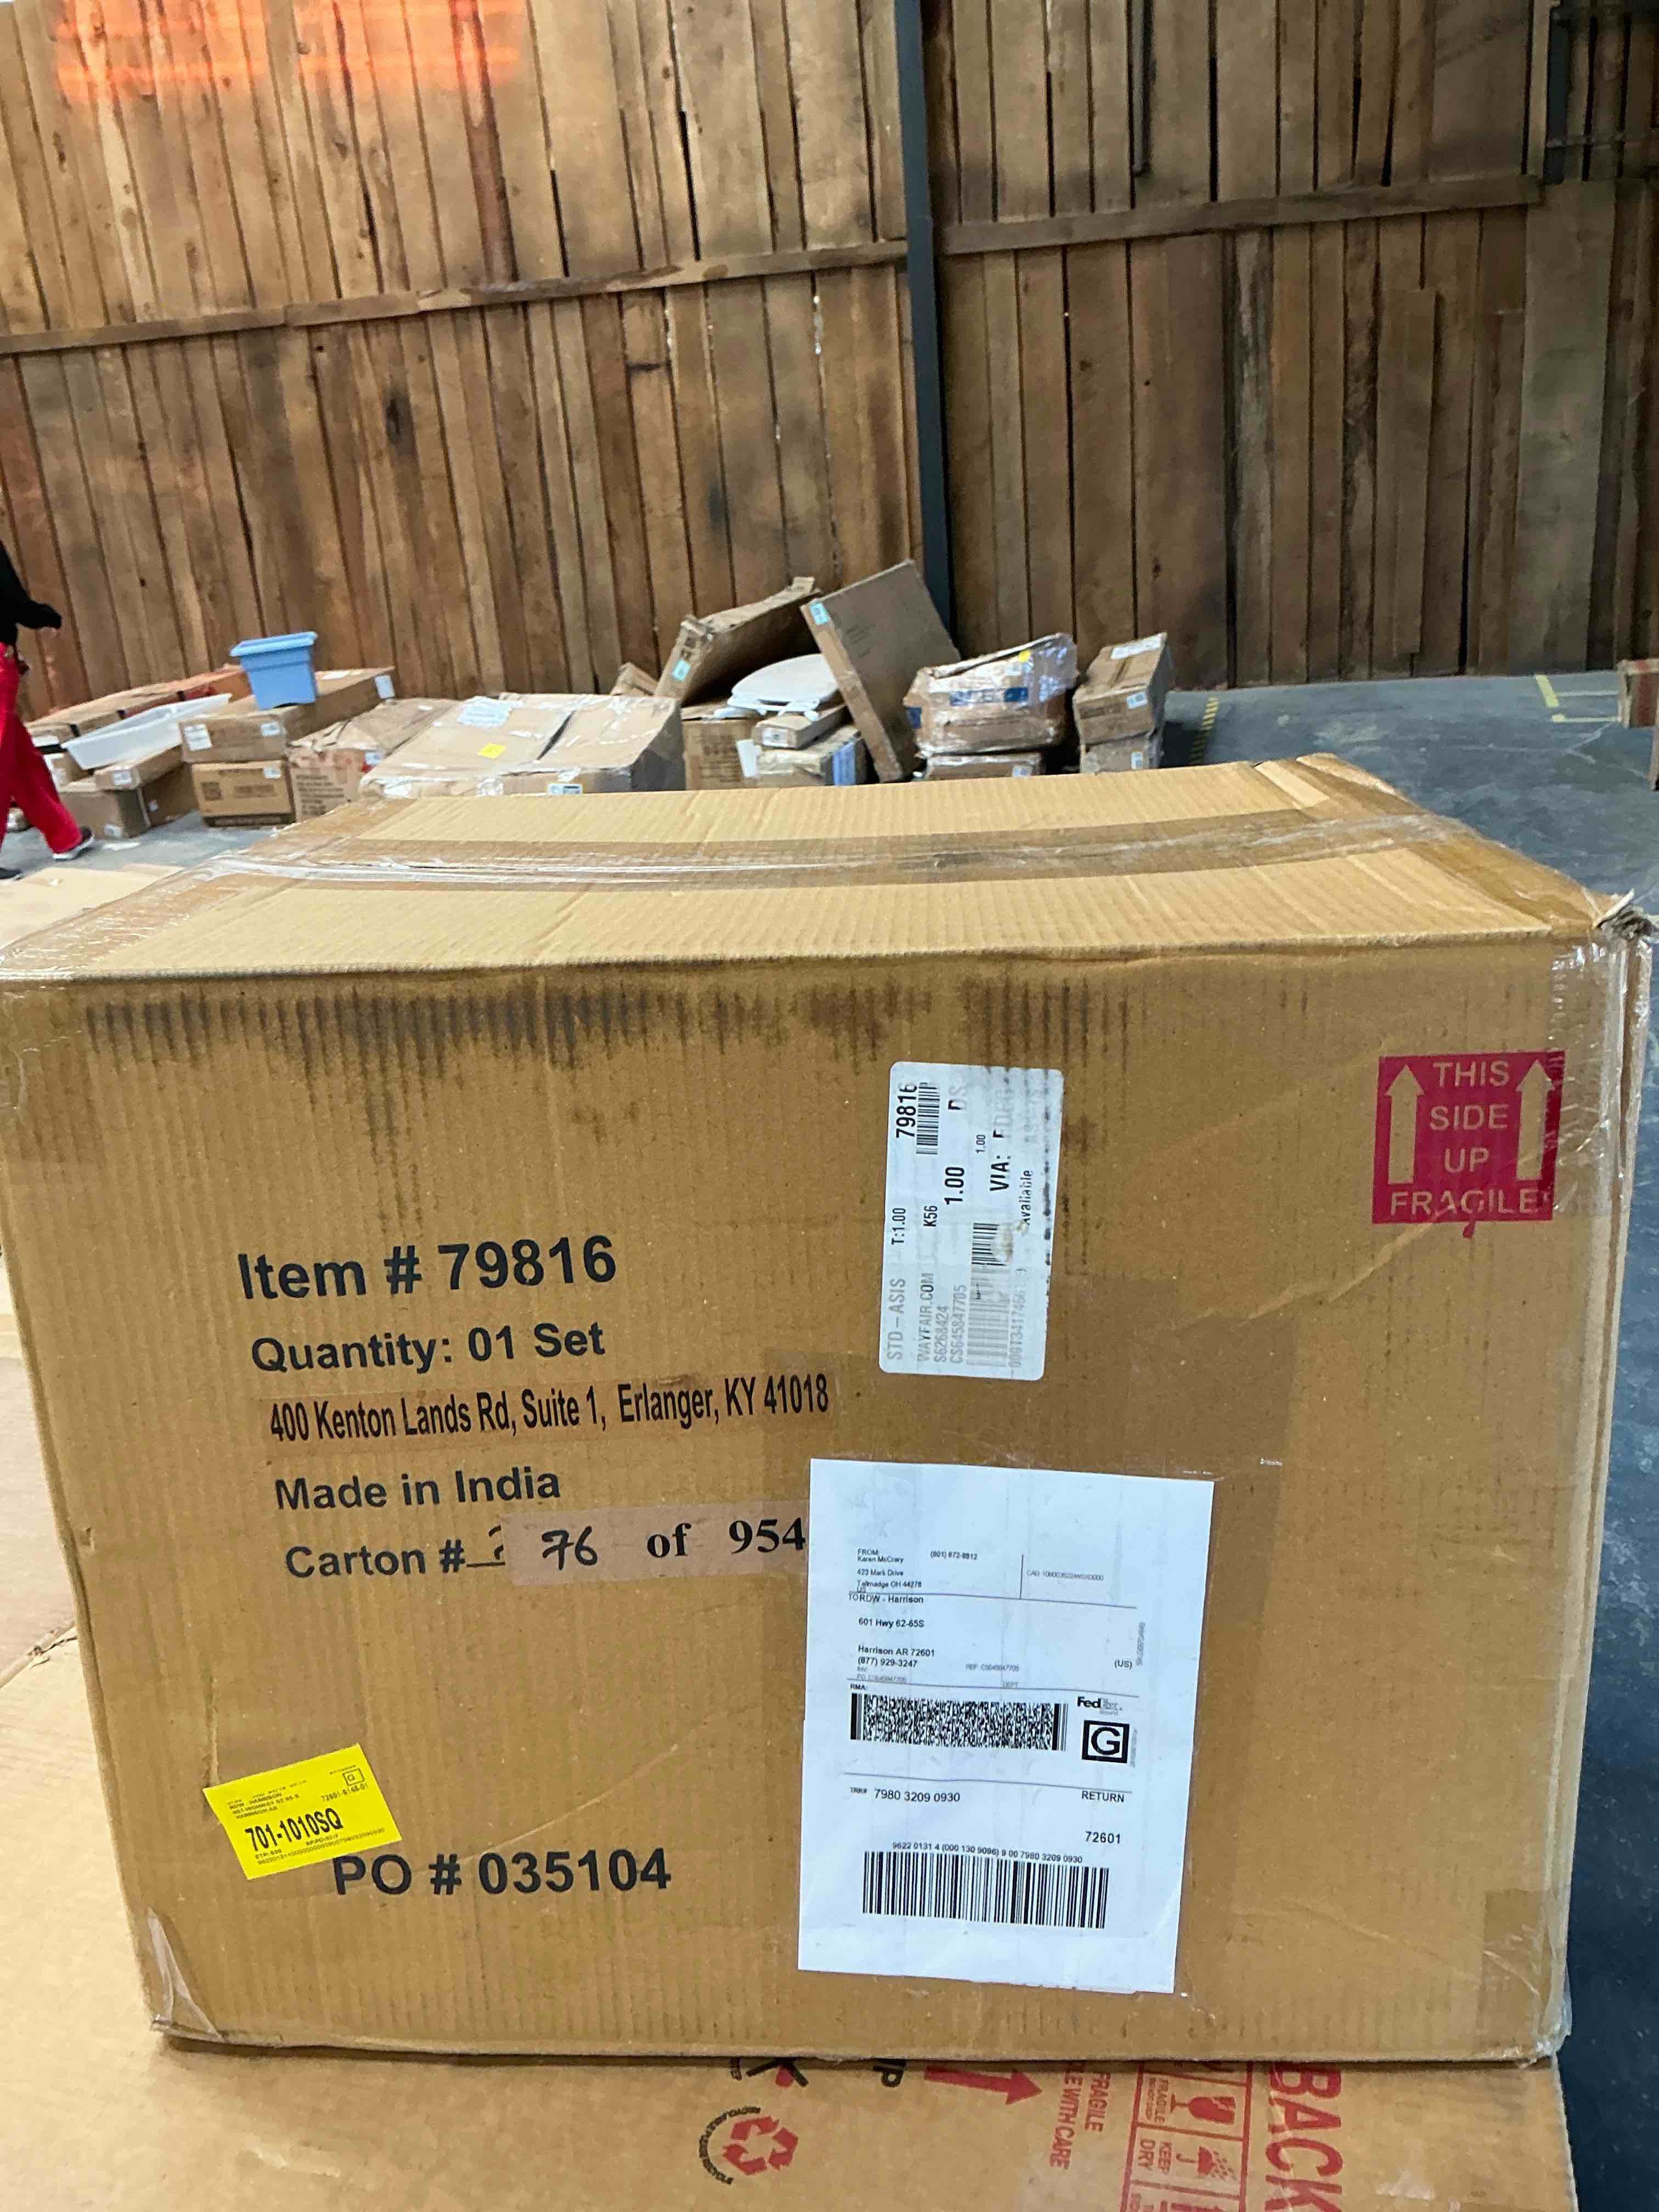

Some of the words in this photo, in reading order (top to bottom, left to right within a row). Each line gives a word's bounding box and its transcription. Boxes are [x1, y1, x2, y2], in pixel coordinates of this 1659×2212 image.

[1432, 1060, 1510, 1088] THIS
[896, 1082, 918, 1138] 79816
[1429, 1103, 1509, 1131] SIDE
[975, 1134, 986, 1154] 1.00
[1444, 1147, 1489, 1173] UP
[944, 1166, 965, 1205] 1.00
[990, 1155, 1011, 1192] VIA:
[923, 1205, 938, 1227] K56
[1390, 1188, 1539, 1216] FRAGILE
[892, 1207, 906, 1245] T:1.00
[238, 1253, 367, 1300] Item
[383, 1245, 422, 1295] #
[438, 1235, 617, 1290] 79816
[251, 1332, 453, 1374] Quantity:
[468, 1325, 515, 1362] 01
[534, 1321, 606, 1358] Set
[269, 1402, 309, 1442] 400
[315, 1401, 397, 1440] Kenton
[402, 1393, 472, 1436] Lands
[476, 1390, 516, 1436] Rd,
[522, 1387, 579, 1430] Suite
[585, 1385, 606, 1432] 1,
[617, 1381, 720, 1432] Erlanger,
[724, 1376, 757, 1418] KY
[764, 1373, 829, 1414] 41018
[275, 1476, 387, 1510] Made
[402, 1473, 439, 1506] in
[455, 1465, 561, 1503] India
[285, 1544, 426, 1579] Carton
[540, 1526, 600, 1571] 76
[646, 1522, 692, 1558] of
[729, 1517, 806, 1555] 954
[888, 1594, 924, 1604] Harrison
[859, 1618, 873, 1626] 601
[876, 1619, 894, 1629] Hwy
[857, 1656, 878, 1667] (877)
[880, 1658, 918, 1668] 929-3247
[858, 1645, 894, 1656] Harrison
[895, 1647, 910, 1656] AR
[911, 1648, 935, 1657] 72601
[1114, 1658, 1133, 1669] (US)
[874, 1788, 901, 1801] 7980
[904, 1790, 931, 1802] 3209
[933, 1791, 961, 1803] 0930
[1081, 1790, 1125, 1803] RETURN
[245, 1807, 344, 1853] 701-1010SQ
[1084, 1831, 1121, 1844] 72601
[892, 1841, 911, 1849] 9622
[913, 1842, 932, 1850] 0131
[961, 1844, 976, 1854] 130
[1008, 1849, 1019, 1858] 00
[1020, 1850, 1040, 1860] 7980
[1042, 1853, 1062, 1862] 3209
[1063, 1854, 1083, 1864] 0930
[332, 1853, 413, 1896] PO
[428, 1853, 462, 1896] #
[478, 1847, 672, 1895] 035104
[1057, 2085, 1081, 2126] WITH
[1084, 2070, 1111, 2134] FRAGILE
[1049, 2125, 1075, 2170] CARE
[1137, 2138, 1156, 2171] DRY
[1264, 2062, 1344, 2212] BACK
